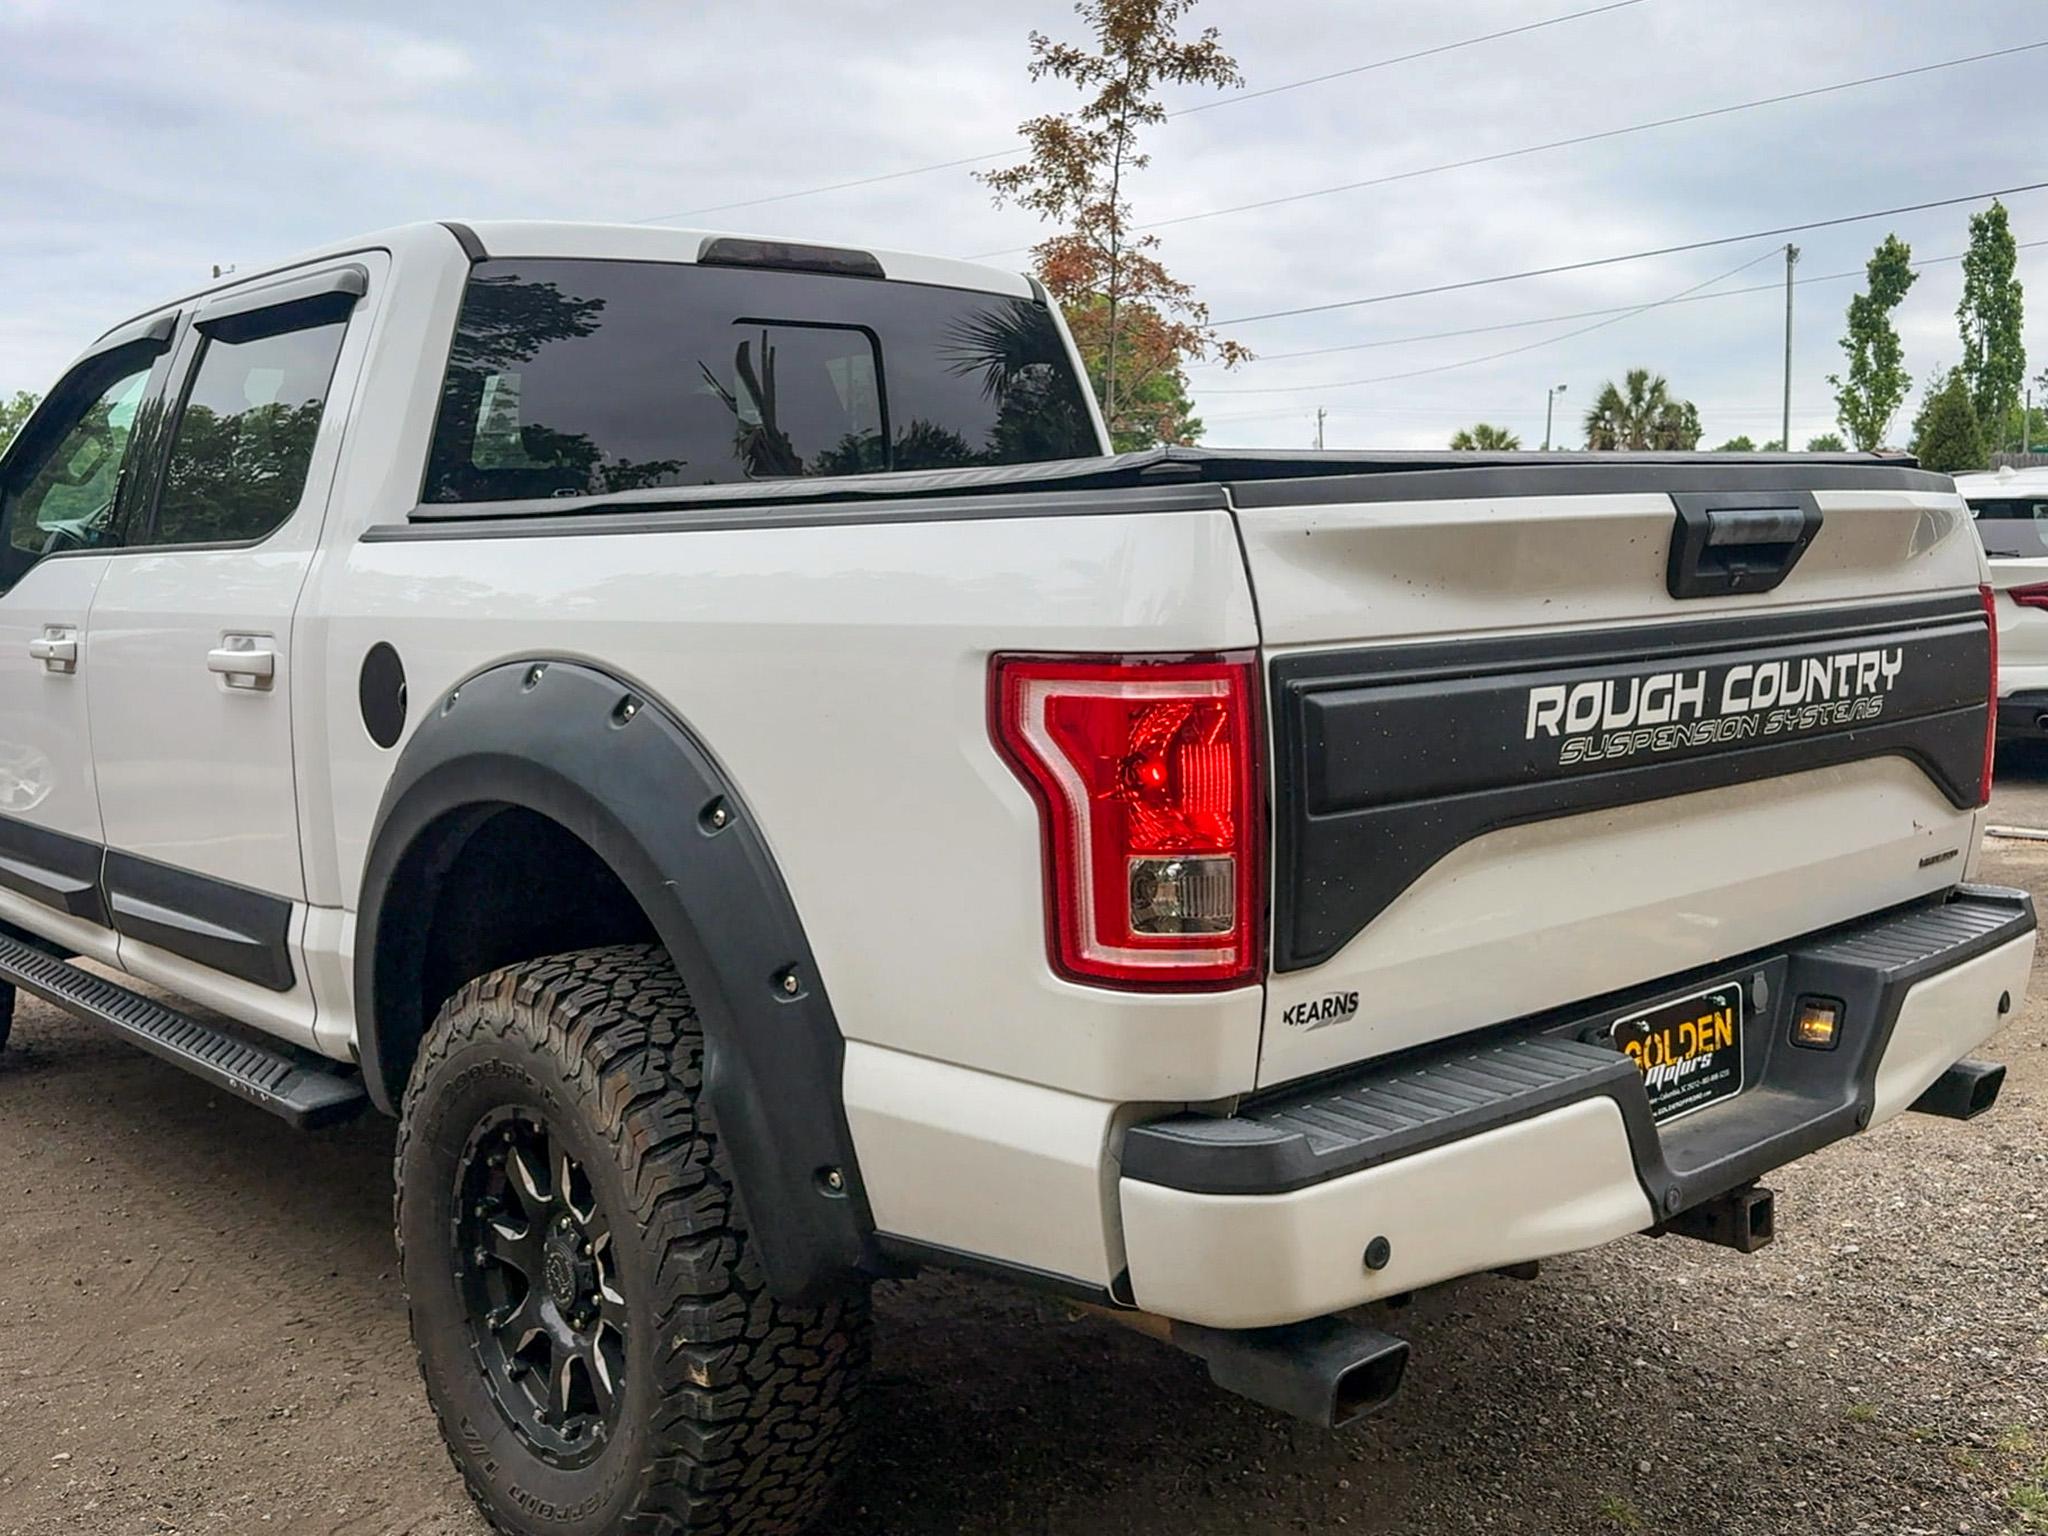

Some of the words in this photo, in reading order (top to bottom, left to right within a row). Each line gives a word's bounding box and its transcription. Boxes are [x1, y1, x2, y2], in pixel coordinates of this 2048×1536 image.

[1526, 670, 1706, 740] ROUGH
[1720, 648, 1903, 715] COUNTRY
[1558, 714, 1759, 765] SUSPENSION
[1764, 695, 1884, 735] SYSTEMS
[1282, 991, 1359, 1026] KEARNS
[1624, 1007, 1733, 1071] GOLDEN
[1644, 1052, 1713, 1092] Motors
